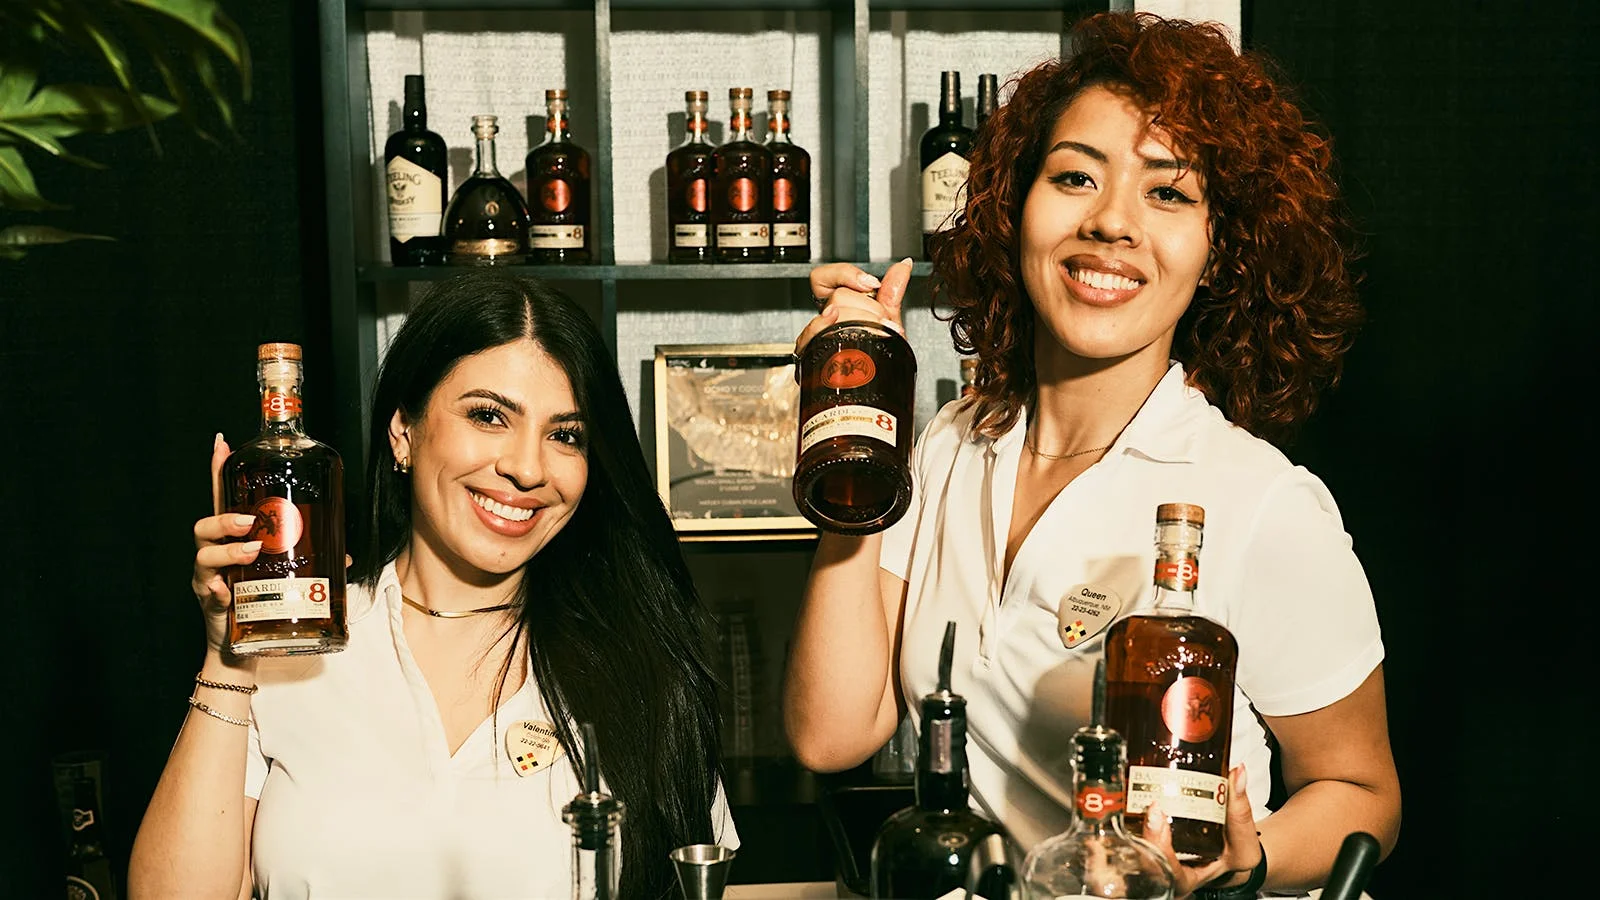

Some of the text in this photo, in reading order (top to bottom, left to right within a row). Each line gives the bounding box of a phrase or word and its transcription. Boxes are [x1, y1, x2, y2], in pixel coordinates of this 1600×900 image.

[573, 227, 582, 240] 8
[759, 226, 768, 239] 8
[798, 224, 806, 238] 8
[269, 397, 286, 412] 8
[875, 414, 893, 432] 8
[1176, 563, 1193, 580] 8
[235, 583, 281, 595] BACARDI
[308, 582, 327, 603] 8
[1081, 588, 1107, 601] Queen
[1216, 783, 1226, 806] 8
[1084, 793, 1104, 812] 8
